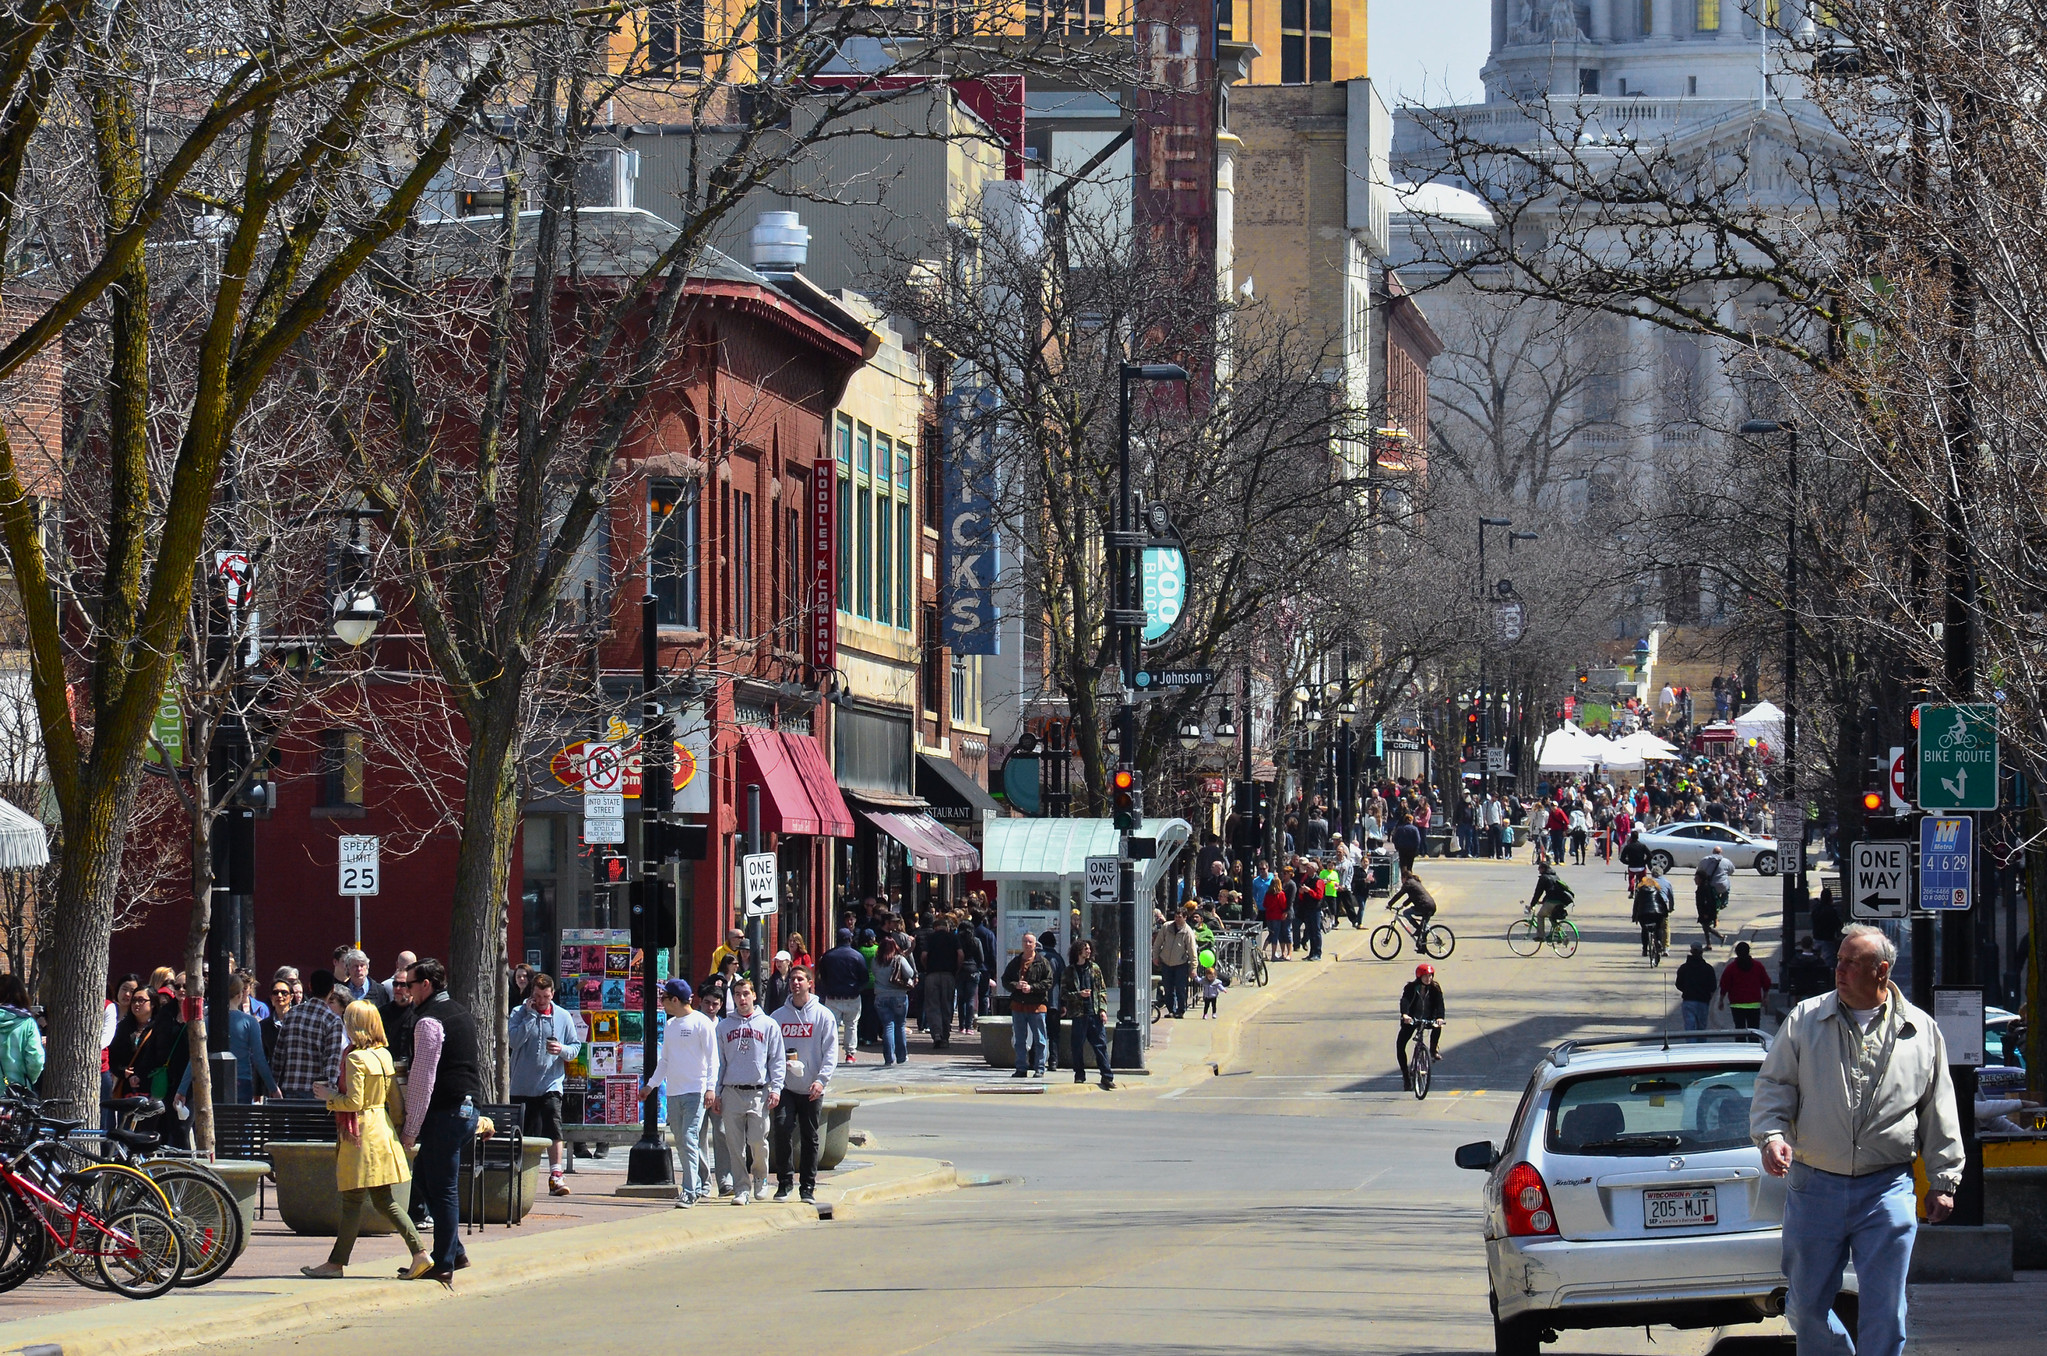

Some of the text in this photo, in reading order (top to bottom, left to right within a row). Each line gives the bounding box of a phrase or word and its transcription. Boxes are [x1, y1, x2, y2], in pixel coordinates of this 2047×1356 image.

[817, 467, 828, 663] NOODLES & COMPANY
[1144, 562, 1157, 624] BLOCK
[1157, 548, 1180, 624] 200
[1160, 671, 1202, 684] Johnson
[1393, 742, 1419, 750] COFFEE
[1924, 751, 1991, 762] BIKE ROUTE
[343, 842, 375, 851] SPEED
[347, 854, 371, 862] LIMIT
[1781, 856, 1797, 871] 15
[1860, 850, 1900, 868] ONE
[1927, 855, 1967, 870] 4 6 29
[749, 860, 772, 875] ONE
[1090, 862, 1114, 873] ONE
[344, 868, 375, 889] 25
[750, 877, 773, 892] WAY
[1089, 875, 1116, 885] WAY
[1859, 872, 1901, 889] WAY
[782, 1024, 812, 1037] OBEY
[1647, 1191, 1684, 1199] WISCONSIN
[1652, 1199, 1709, 1218] 205-MJT
